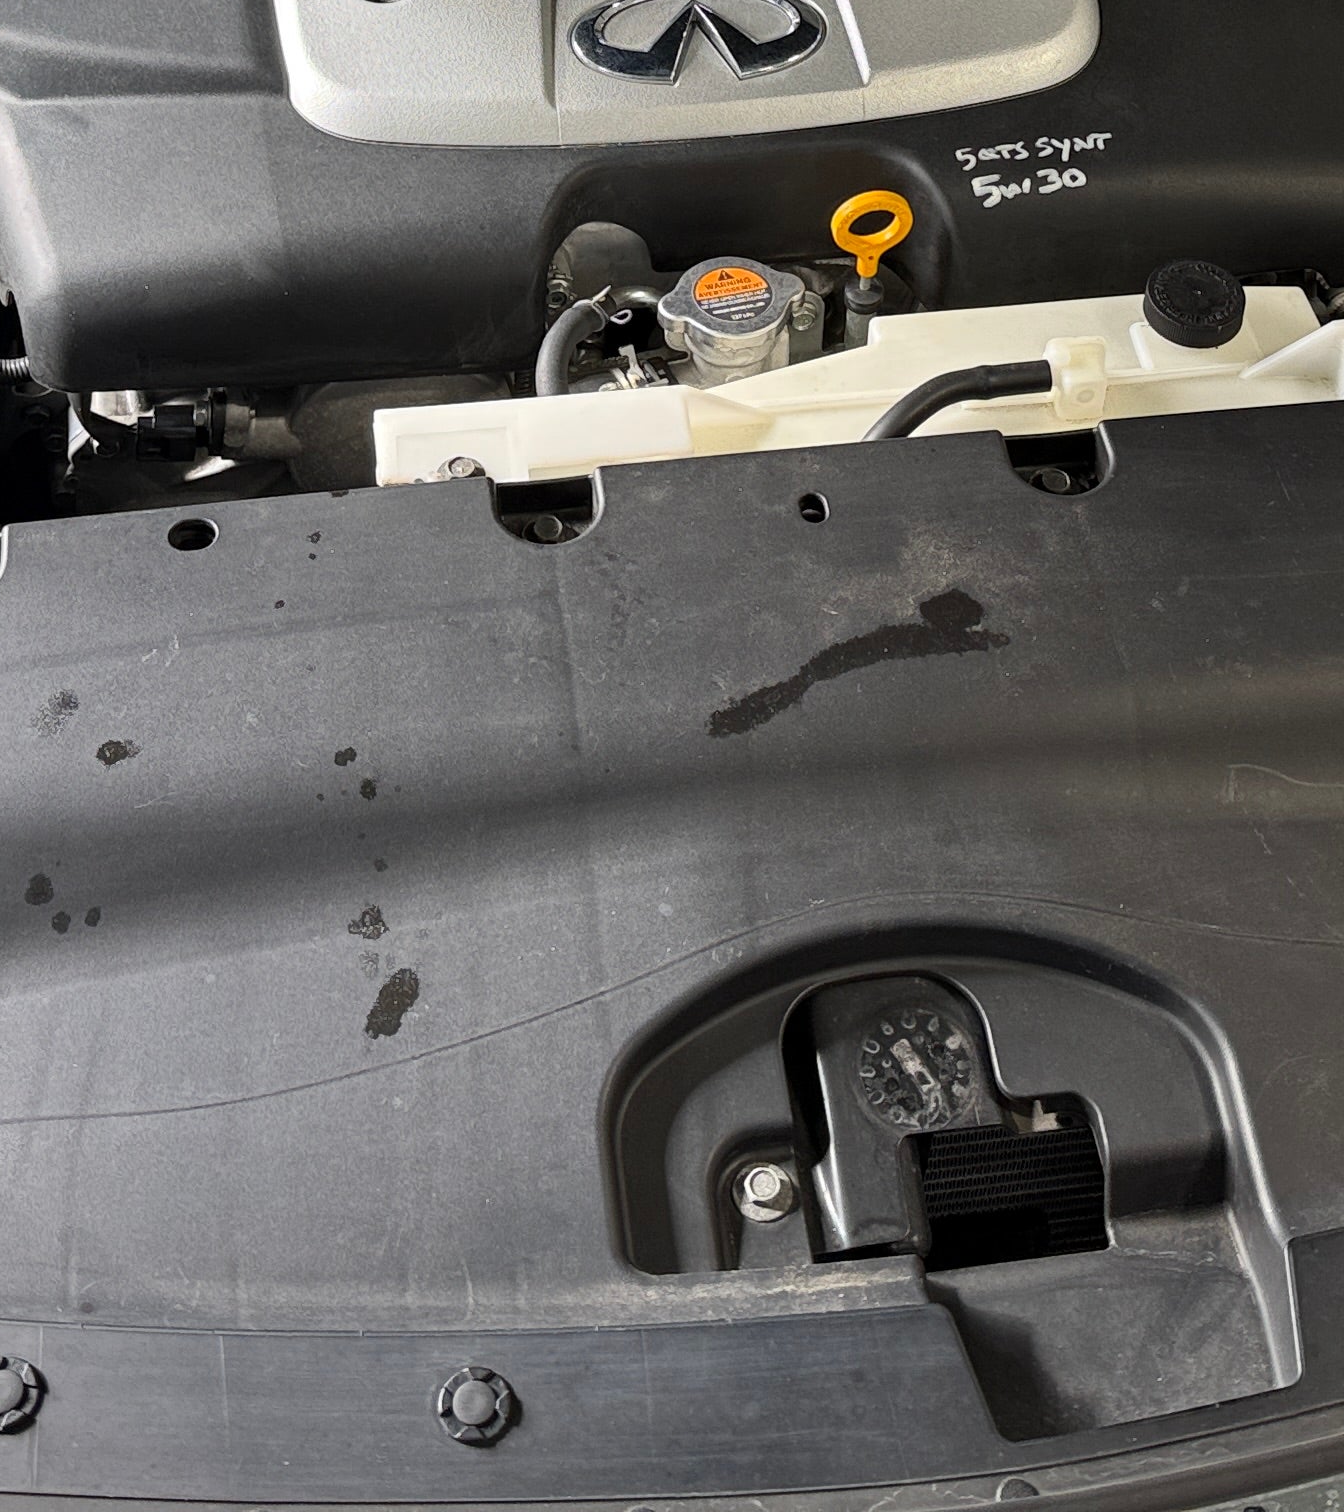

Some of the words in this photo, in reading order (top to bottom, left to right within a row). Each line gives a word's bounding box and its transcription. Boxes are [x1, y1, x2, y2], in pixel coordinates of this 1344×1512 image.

[1035, 132, 1113, 162] SYNT
[1036, 167, 1088, 195] 30
[698, 281, 764, 298] AVERTISSEMENT
[704, 276, 752, 291] WARNING
